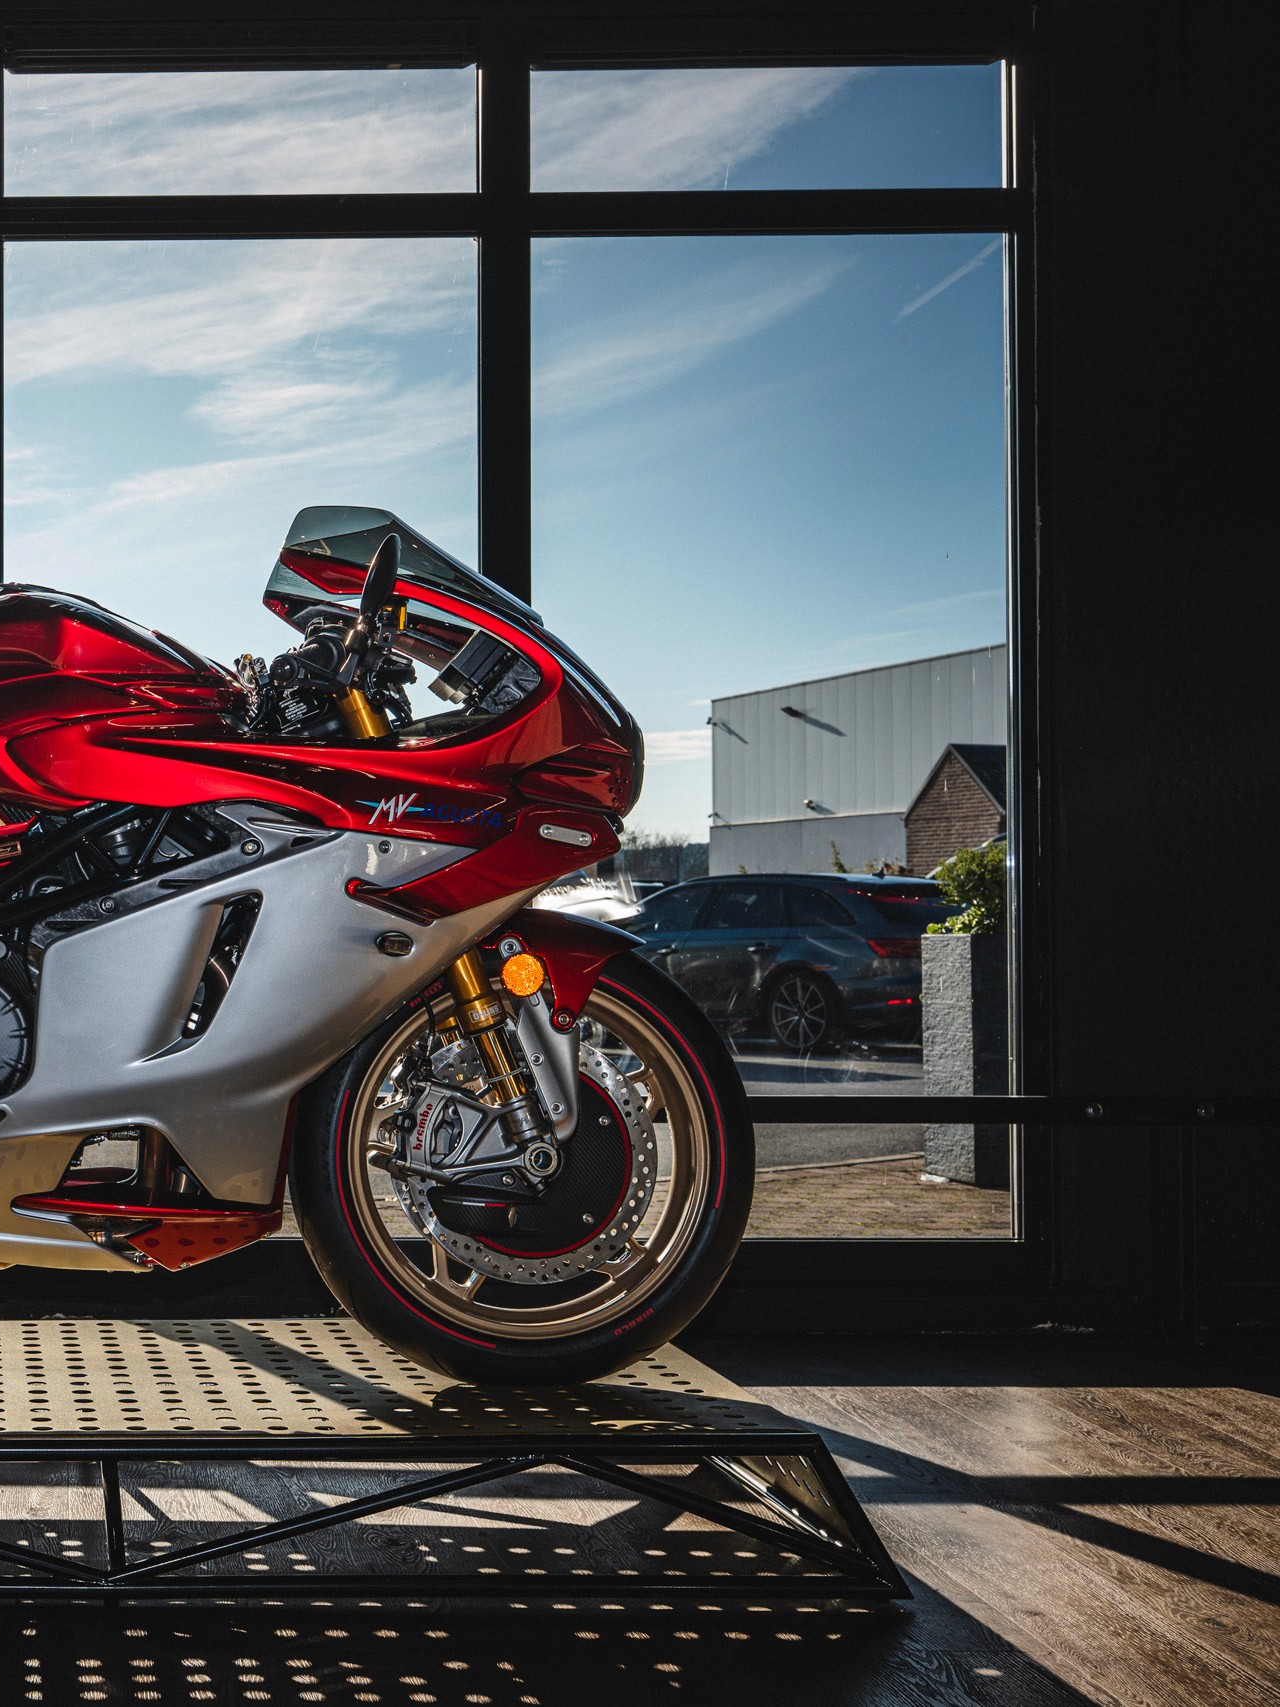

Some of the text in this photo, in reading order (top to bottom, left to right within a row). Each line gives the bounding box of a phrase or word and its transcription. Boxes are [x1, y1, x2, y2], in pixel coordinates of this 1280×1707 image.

[368, 792, 502, 828] MV AGUSTA
[412, 1103, 433, 1151] brembo
[614, 1307, 655, 1336] DIABLO
